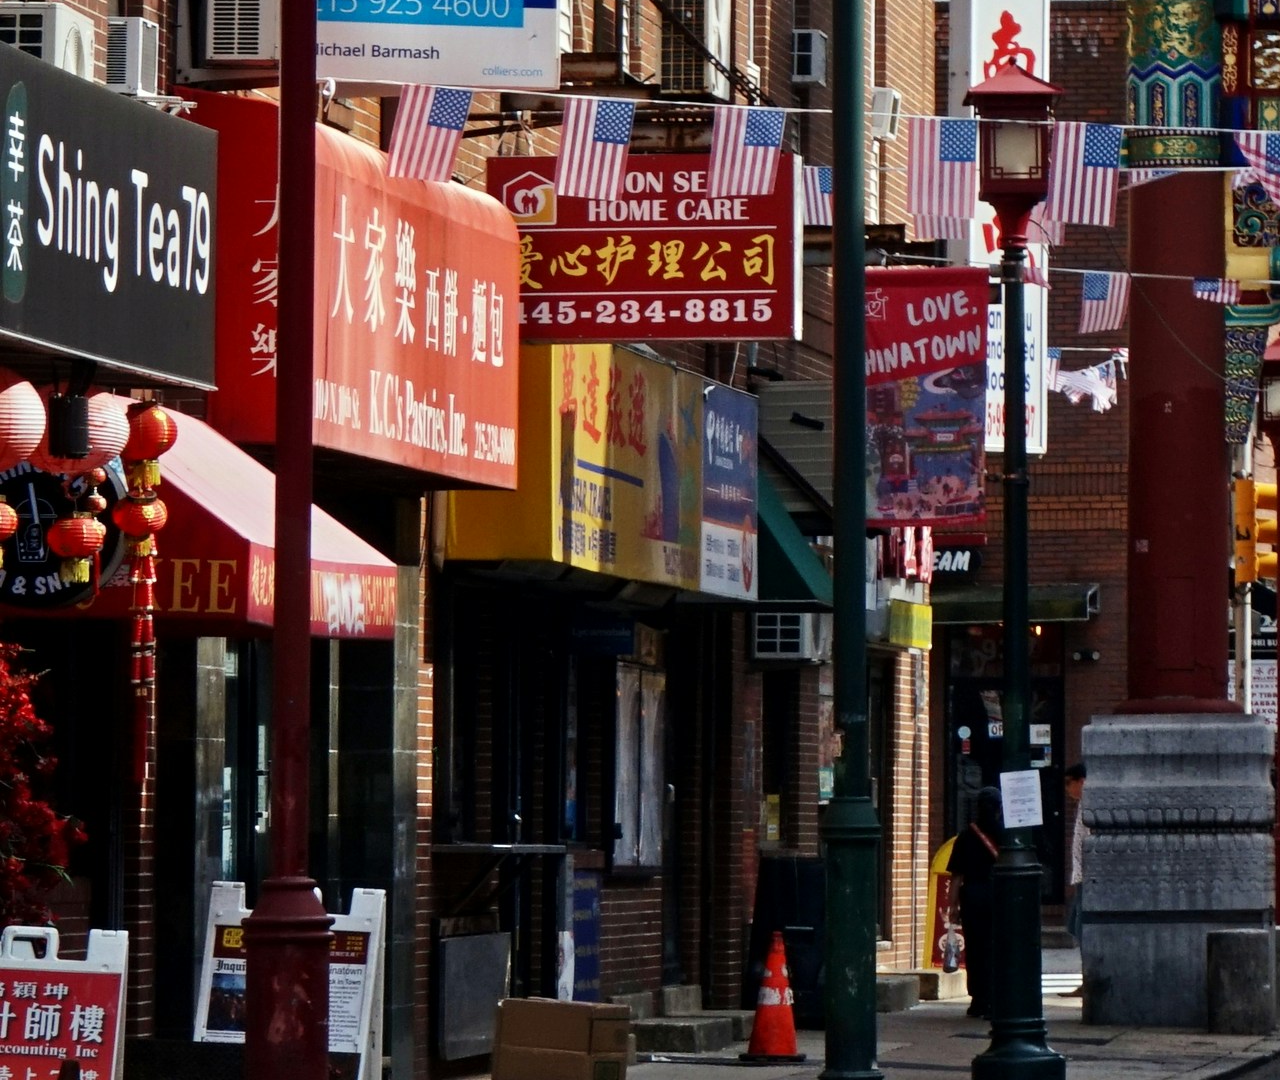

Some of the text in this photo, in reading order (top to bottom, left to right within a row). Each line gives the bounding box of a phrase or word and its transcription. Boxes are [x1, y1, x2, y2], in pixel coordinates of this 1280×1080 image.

[371, 44, 440, 60] Barmash
[482, 66, 543, 78] colliers.com
[37, 133, 120, 293] Shing
[588, 198, 750, 223] HOME CARE
[331, 193, 417, 345] 大家樂
[906, 290, 978, 328] LOVE,
[865, 325, 982, 376] HINATOWN
[369, 369, 403, 441] K.C.'s
[404, 379, 448, 459] Pastries,
[448, 393, 469, 457] Inc.
[216, 959, 247, 972] Inqui
[0, 1043, 100, 1060] ccounting Inc
